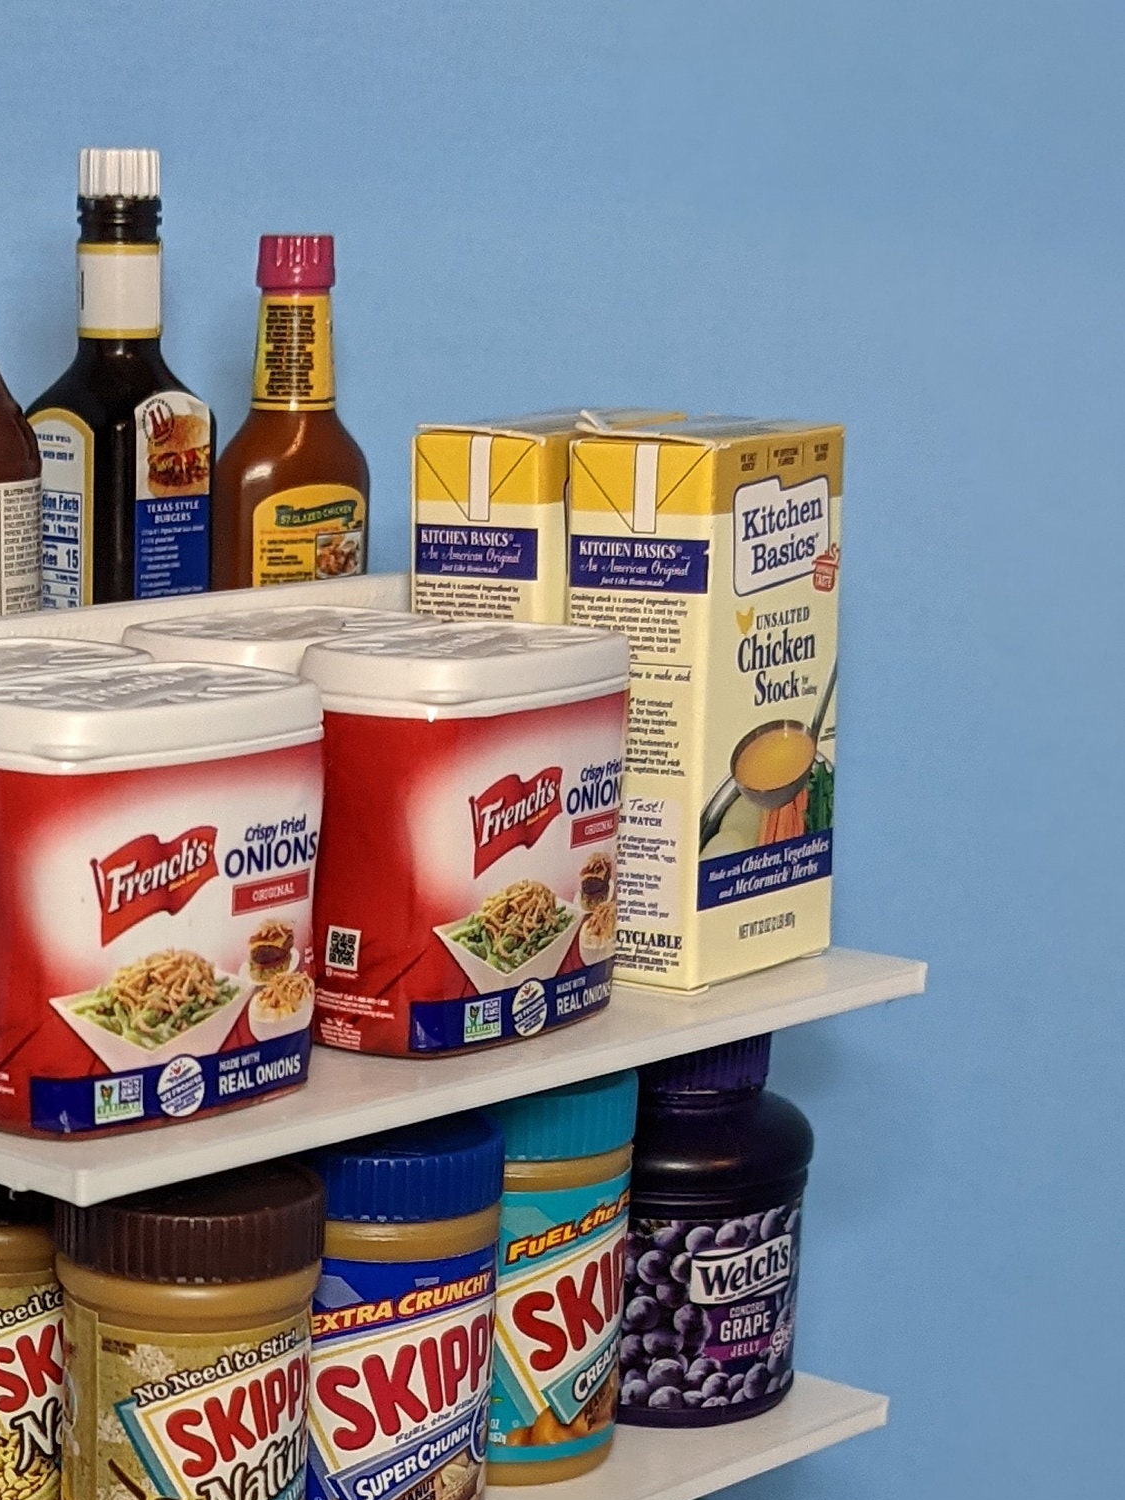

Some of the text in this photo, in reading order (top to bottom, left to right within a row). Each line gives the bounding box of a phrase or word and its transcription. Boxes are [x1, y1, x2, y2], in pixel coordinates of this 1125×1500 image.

[59, 495, 79, 512] Facts
[155, 512, 191, 523] BURGERS
[742, 497, 824, 542] Kitchen
[421, 529, 509, 547] KITCHEN BASICS
[579, 541, 676, 559] KITCHEN BASICS
[65, 549, 79, 569] 15
[442, 546, 483, 561] American
[486, 548, 522, 569] Original
[751, 533, 816, 575] Basics
[601, 558, 647, 574] American
[651, 560, 691, 582] Original
[756, 606, 810, 630] UNSALTED
[737, 627, 816, 673] Chicken
[754, 670, 800, 706] Stock
[580, 764, 604, 783] Crispy
[479, 778, 555, 848] French's
[629, 799, 665, 813] Test!
[245, 814, 307, 843] Crispy Fried
[629, 816, 662, 827] WATCH
[225, 831, 318, 879] ONIONS
[742, 852, 782, 874] Chicken,
[784, 838, 829, 864] Vegetables
[107, 837, 209, 914] French's
[734, 866, 788, 895] McCormick
[791, 859, 818, 880] Herbs
[252, 881, 295, 902] ORIGINAL
[616, 929, 683, 950] CYCLABLE
[557, 982, 611, 1016] REAL ONIONS
[219, 1058, 240, 1072] MADE
[219, 1055, 301, 1096] REAL ONIONS
[580, 1203, 614, 1234] the
[696, 1242, 789, 1296] Welch's
[310, 1271, 492, 1335] EXTRA CRUNCHY
[730, 1301, 765, 1318] CONCORD
[720, 1310, 771, 1343] GRAPE
[730, 1340, 761, 1358] JELLY
[134, 1332, 297, 1407] No Need to Stir!
